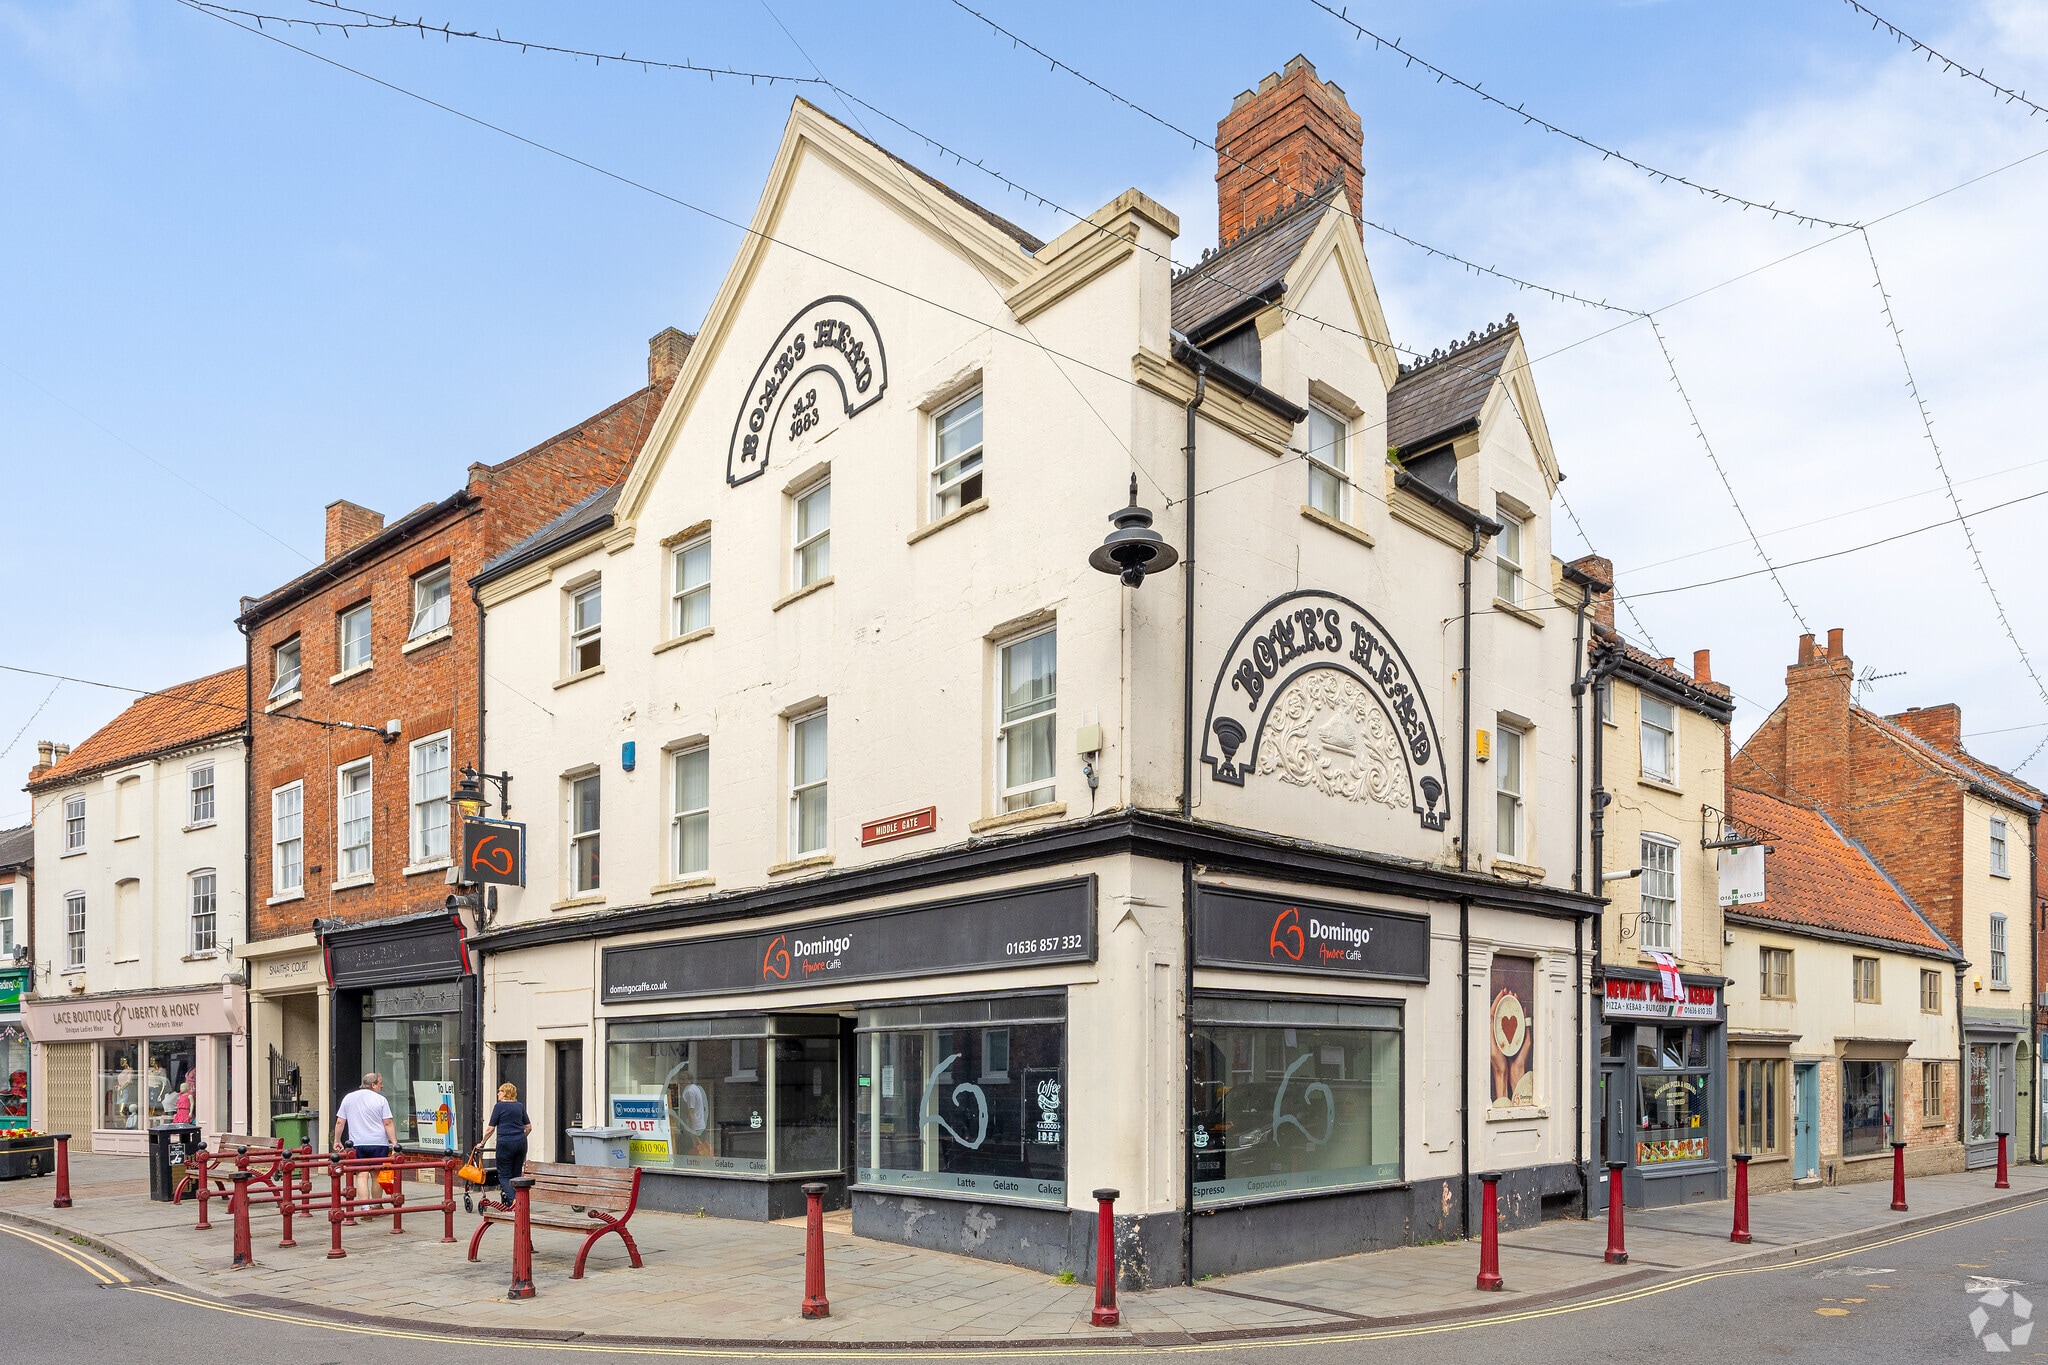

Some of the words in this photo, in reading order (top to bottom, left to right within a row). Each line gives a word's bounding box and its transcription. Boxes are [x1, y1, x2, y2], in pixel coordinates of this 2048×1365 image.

[813, 319, 873, 393] HEAD
[1231, 607, 1342, 712] BOAR'S
[1350, 620, 1431, 766] HEAD
[876, 822, 898, 836] MIDDLE
[902, 817, 918, 830] GATE
[1310, 919, 1370, 947] Domingo
[794, 935, 850, 958] Domingo
[1006, 940, 1037, 955] 01636
[1039, 937, 1059, 951] 857
[1062, 934, 1082, 949] 332
[1319, 941, 1345, 966] Amore
[292, 960, 309, 973] COURT
[802, 959, 826, 978] Amore
[609, 980, 668, 995] domingocaffe.co.uk
[1606, 980, 1648, 1001] NEWARK
[1688, 985, 1715, 1005] KEBAB
[53, 1011, 72, 1025] LACE
[73, 1008, 113, 1024] BOUTIQUE
[127, 1005, 159, 1020] LIBERTY
[161, 1005, 168, 1017] &
[170, 1002, 201, 1017] HONEY
[1605, 1001, 1622, 1010] PIZZA
[1625, 1002, 1642, 1011] KEBAB
[1645, 1004, 1668, 1013] BURGERS
[65, 1026, 80, 1034] Unique
[80, 1025, 94, 1033] Ladies
[171, 1020, 184, 1028] Wear
[437, 1083, 443, 1093] To
[445, 1083, 454, 1093] Let
[1037, 1078, 1061, 1097] Coffee
[417, 1109, 438, 1121] mathias
[625, 1121, 636, 1130] TO
[639, 1121, 654, 1131] LET
[1038, 1131, 1060, 1141] IDEA
[641, 1143, 653, 1152] 610
[653, 1143, 667, 1153] 906
[715, 1159, 734, 1169] Gelato
[749, 1161, 767, 1171] Cakes
[957, 1177, 976, 1188] Latte
[993, 1179, 1019, 1191] Gelato
[1037, 1183, 1062, 1195] Cakes
[1193, 1186, 1225, 1197] Espresso
[1247, 1178, 1287, 1191] Cappuccino
